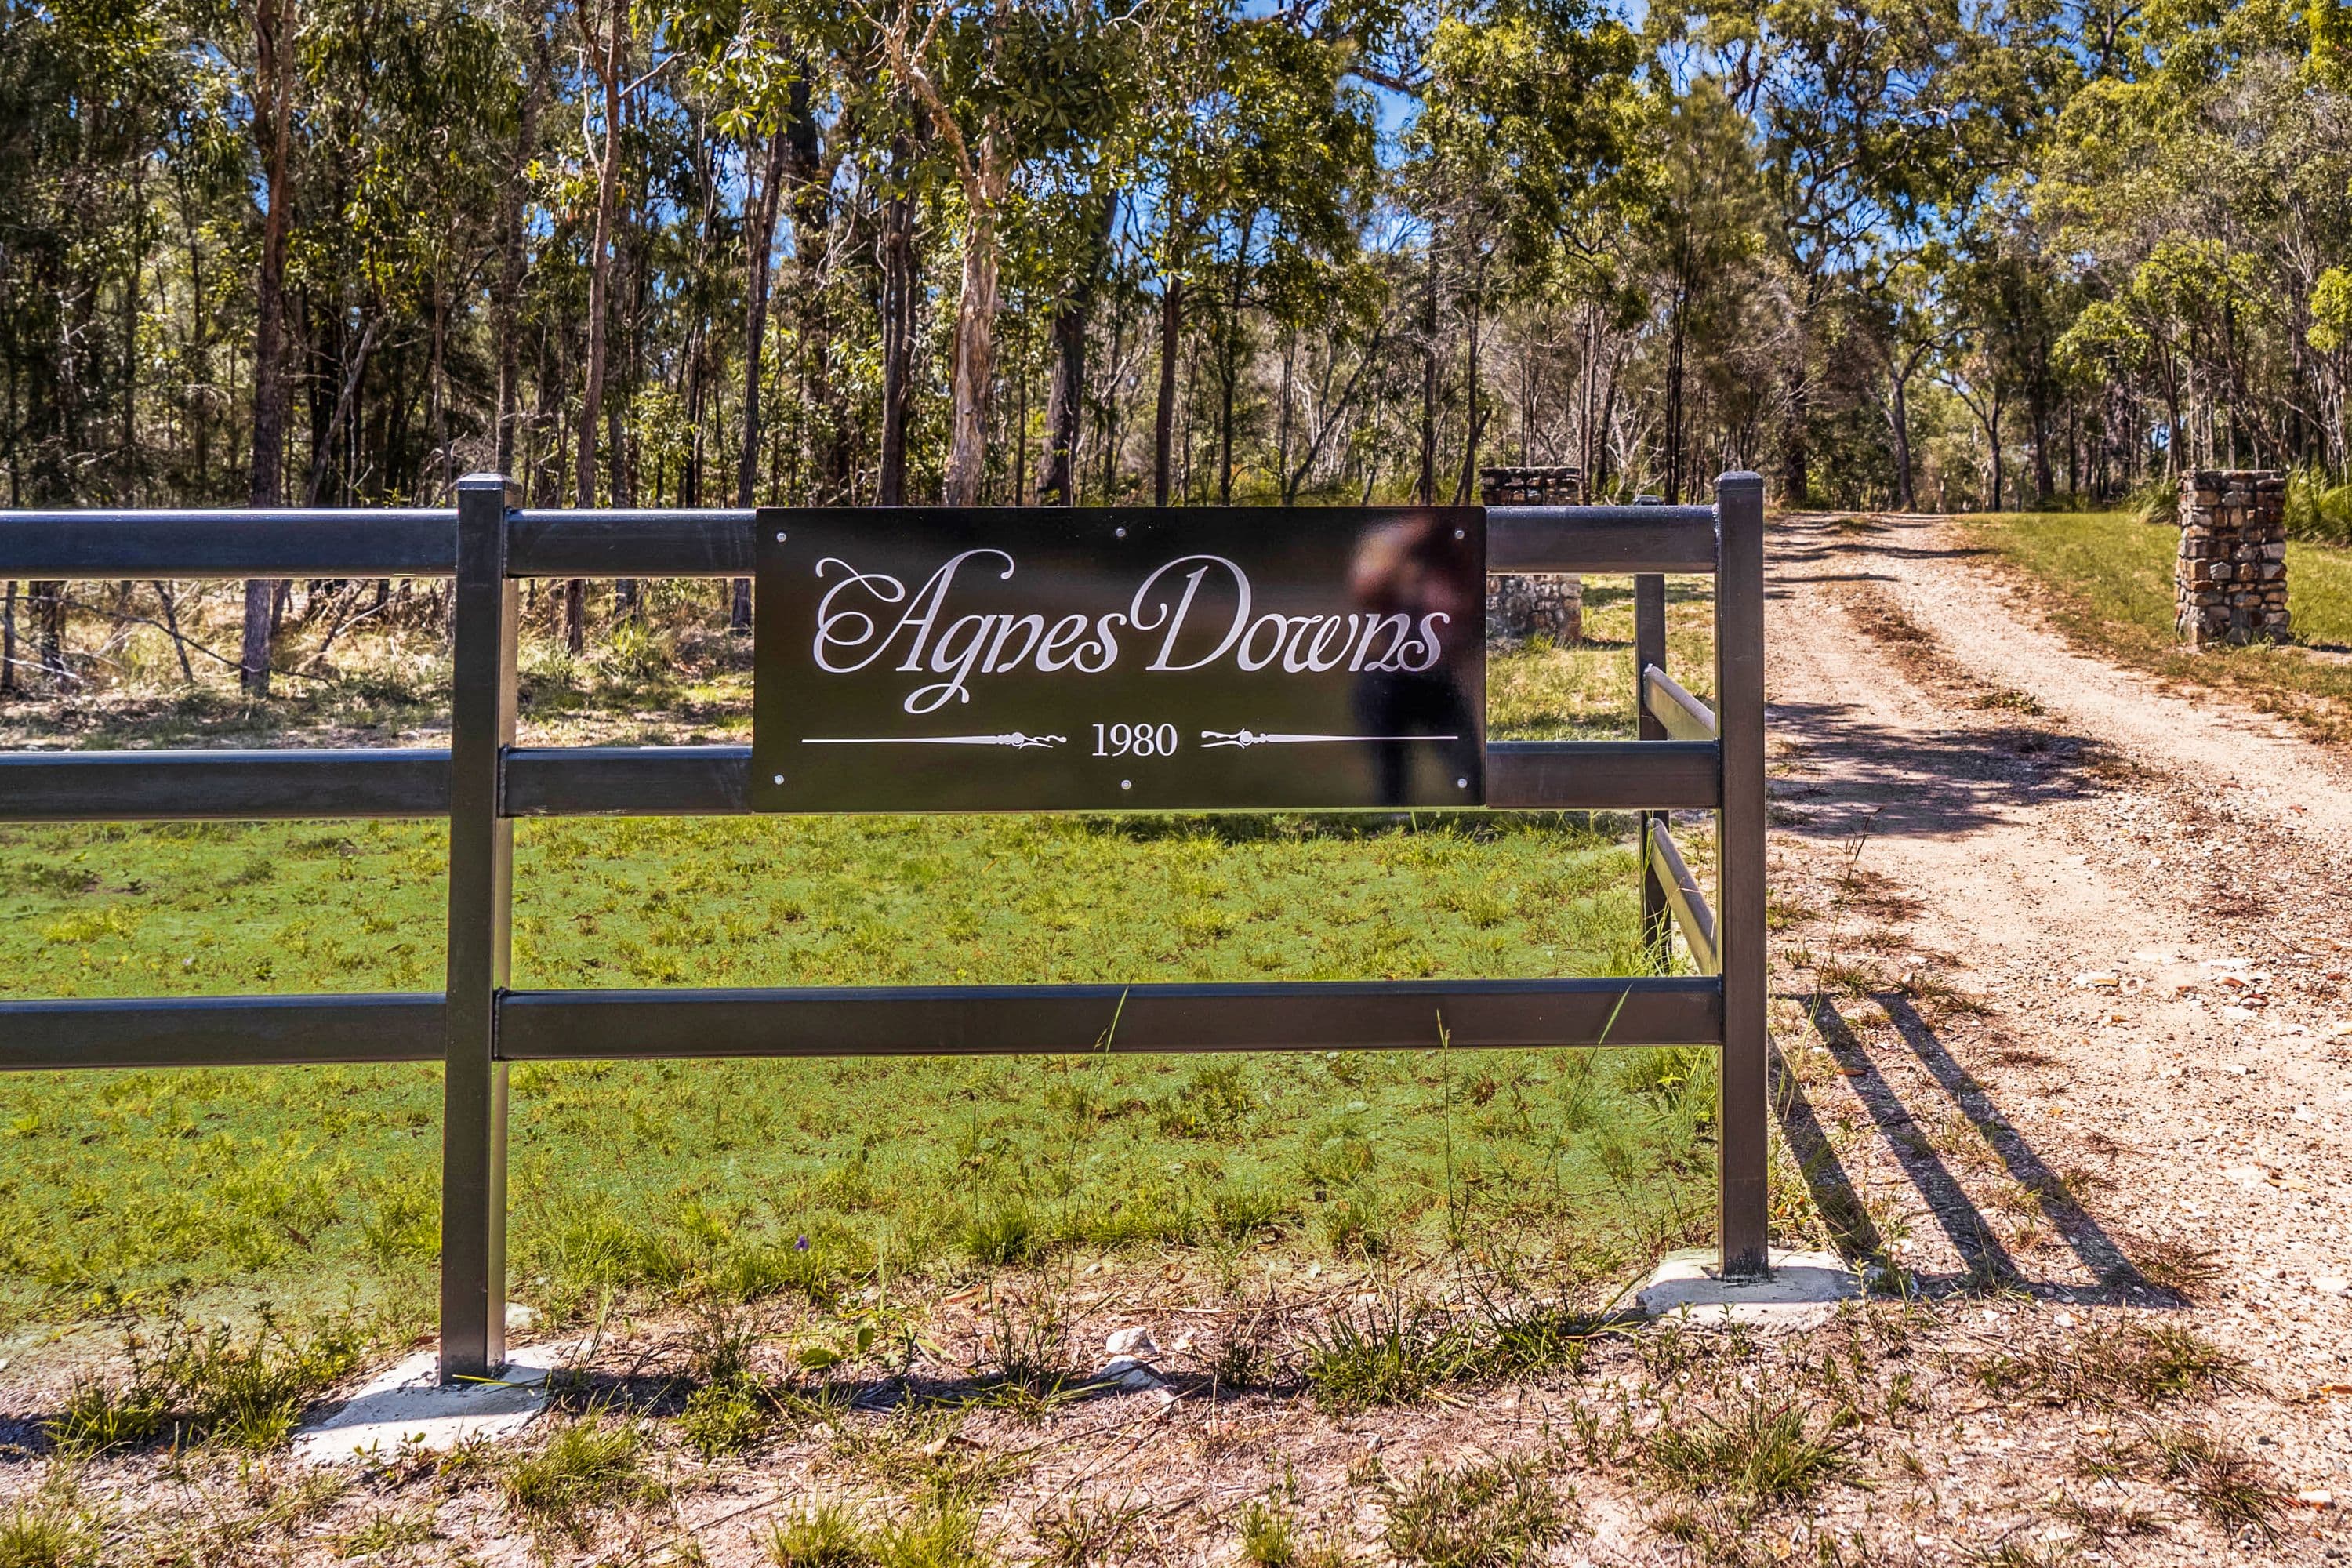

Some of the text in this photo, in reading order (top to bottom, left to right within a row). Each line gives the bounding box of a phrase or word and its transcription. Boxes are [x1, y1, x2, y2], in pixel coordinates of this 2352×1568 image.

[813, 548, 1450, 714] Agnes Downs
[1091, 723, 1178, 757] 1980
